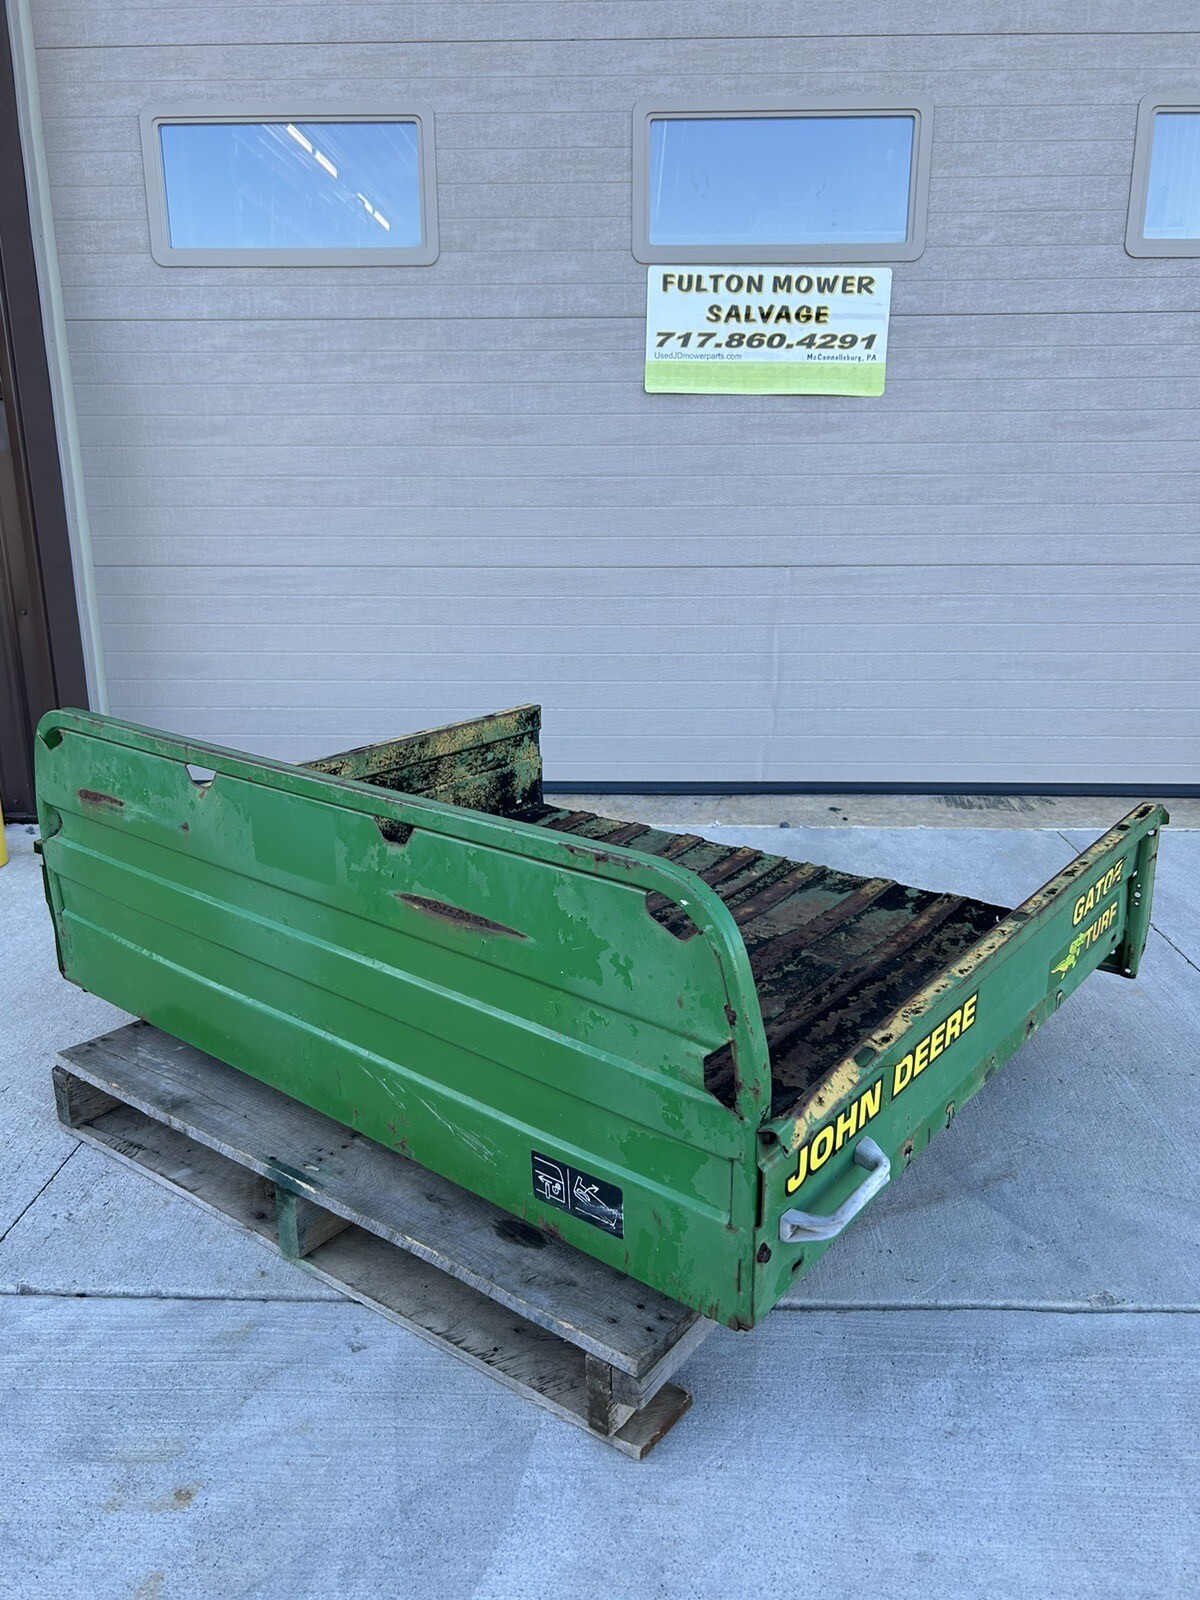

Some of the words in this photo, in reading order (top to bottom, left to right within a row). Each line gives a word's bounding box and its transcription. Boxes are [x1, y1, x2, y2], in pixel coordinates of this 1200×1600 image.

[662, 273, 763, 294] FULTON
[772, 275, 876, 295] MOWER
[706, 304, 830, 324] SALVAGE
[655, 332, 878, 350] 717.860.4291
[654, 351, 742, 361] UsedJDmowerparts.com
[1085, 901, 1118, 950] TURF
[786, 1077, 883, 1195] JOHN
[892, 991, 979, 1098] DEERE
